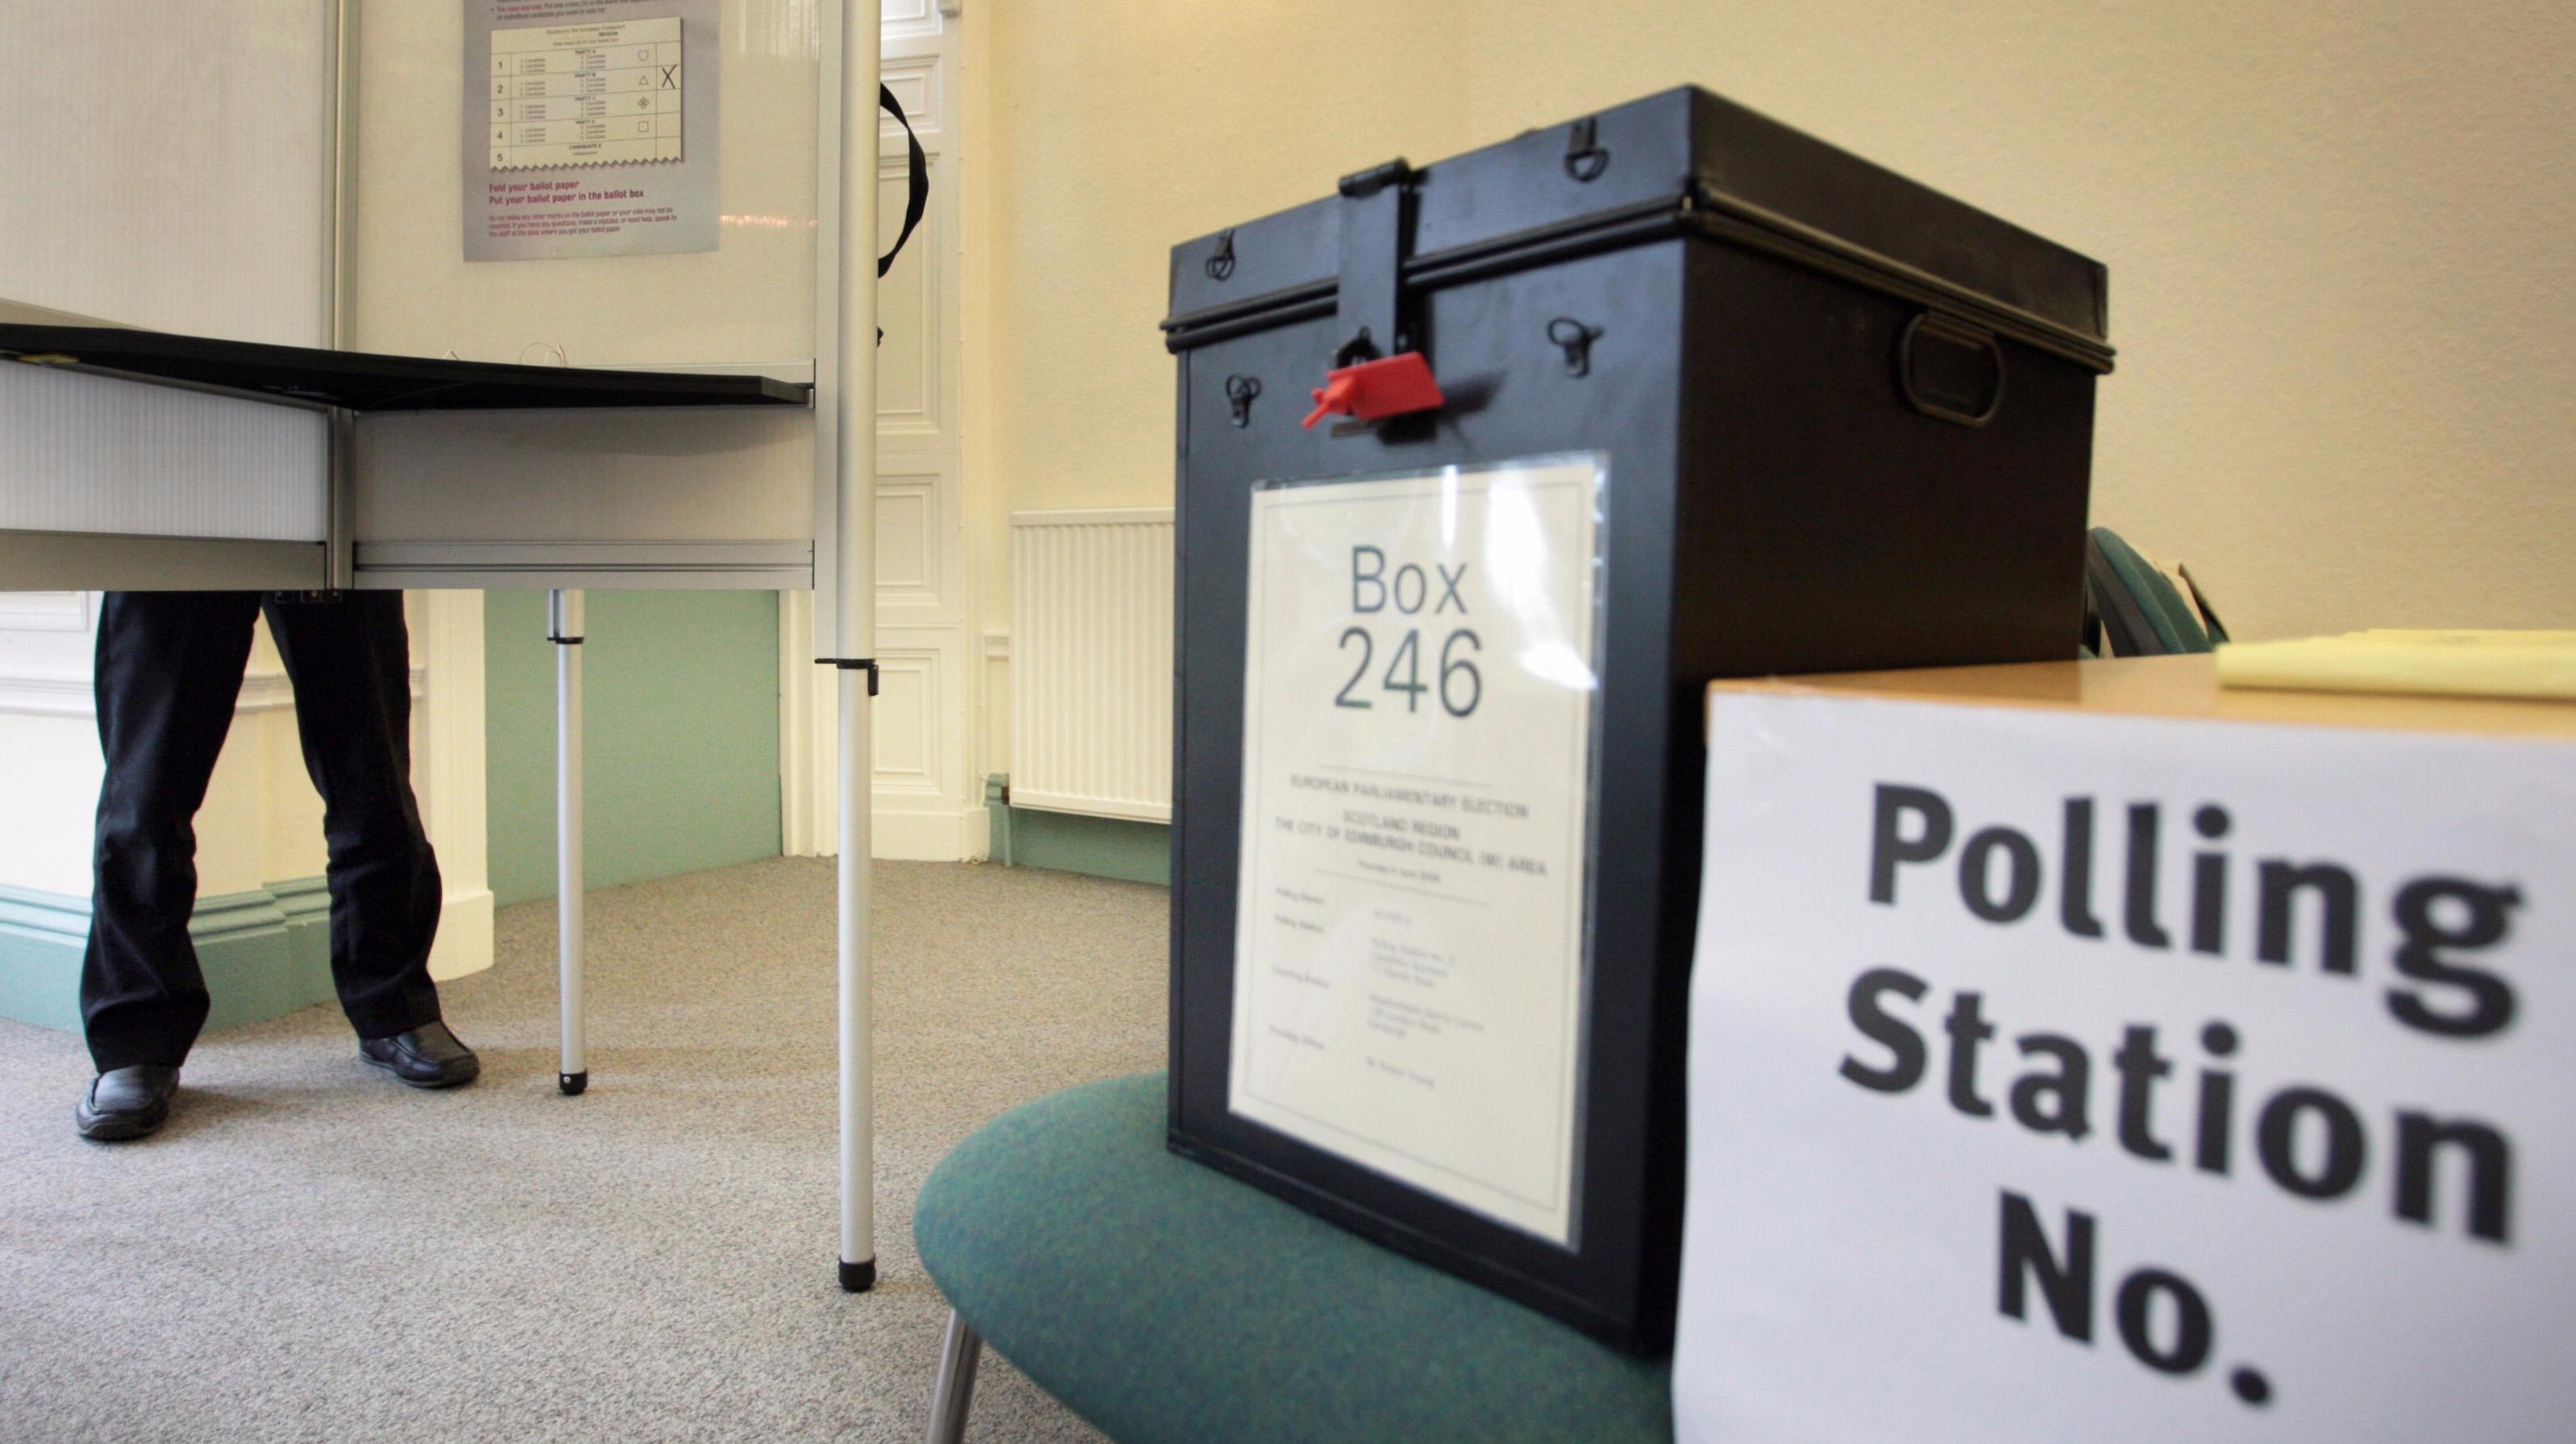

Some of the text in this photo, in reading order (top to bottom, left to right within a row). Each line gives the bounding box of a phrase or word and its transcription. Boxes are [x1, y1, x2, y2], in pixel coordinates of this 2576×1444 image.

[497, 85, 503, 94] 2
[498, 108, 503, 116] 3
[497, 153, 503, 161] 5
[490, 181, 580, 193] Fold your ballot paper
[490, 189, 644, 206] Put your ballot paper in the ballot box
[1352, 544, 1468, 615] Box
[1335, 626, 1482, 718] 246
[1290, 773, 1530, 819] EUROPEAN PARLIAMENTARY ELECTION
[1275, 815, 1294, 833] THE
[1297, 818, 1322, 837] CITY
[1325, 823, 1340, 839] OF
[1344, 828, 1415, 853] EDINBURGH
[1418, 841, 1474, 864] COUNCIL
[1508, 855, 1548, 876] AREA
[1343, 809, 1460, 840] SCOTLAND REGION
[1868, 781, 2524, 1040] Polling
[1838, 966, 2515, 1246] Station
[1996, 1186, 2275, 1409] No.
